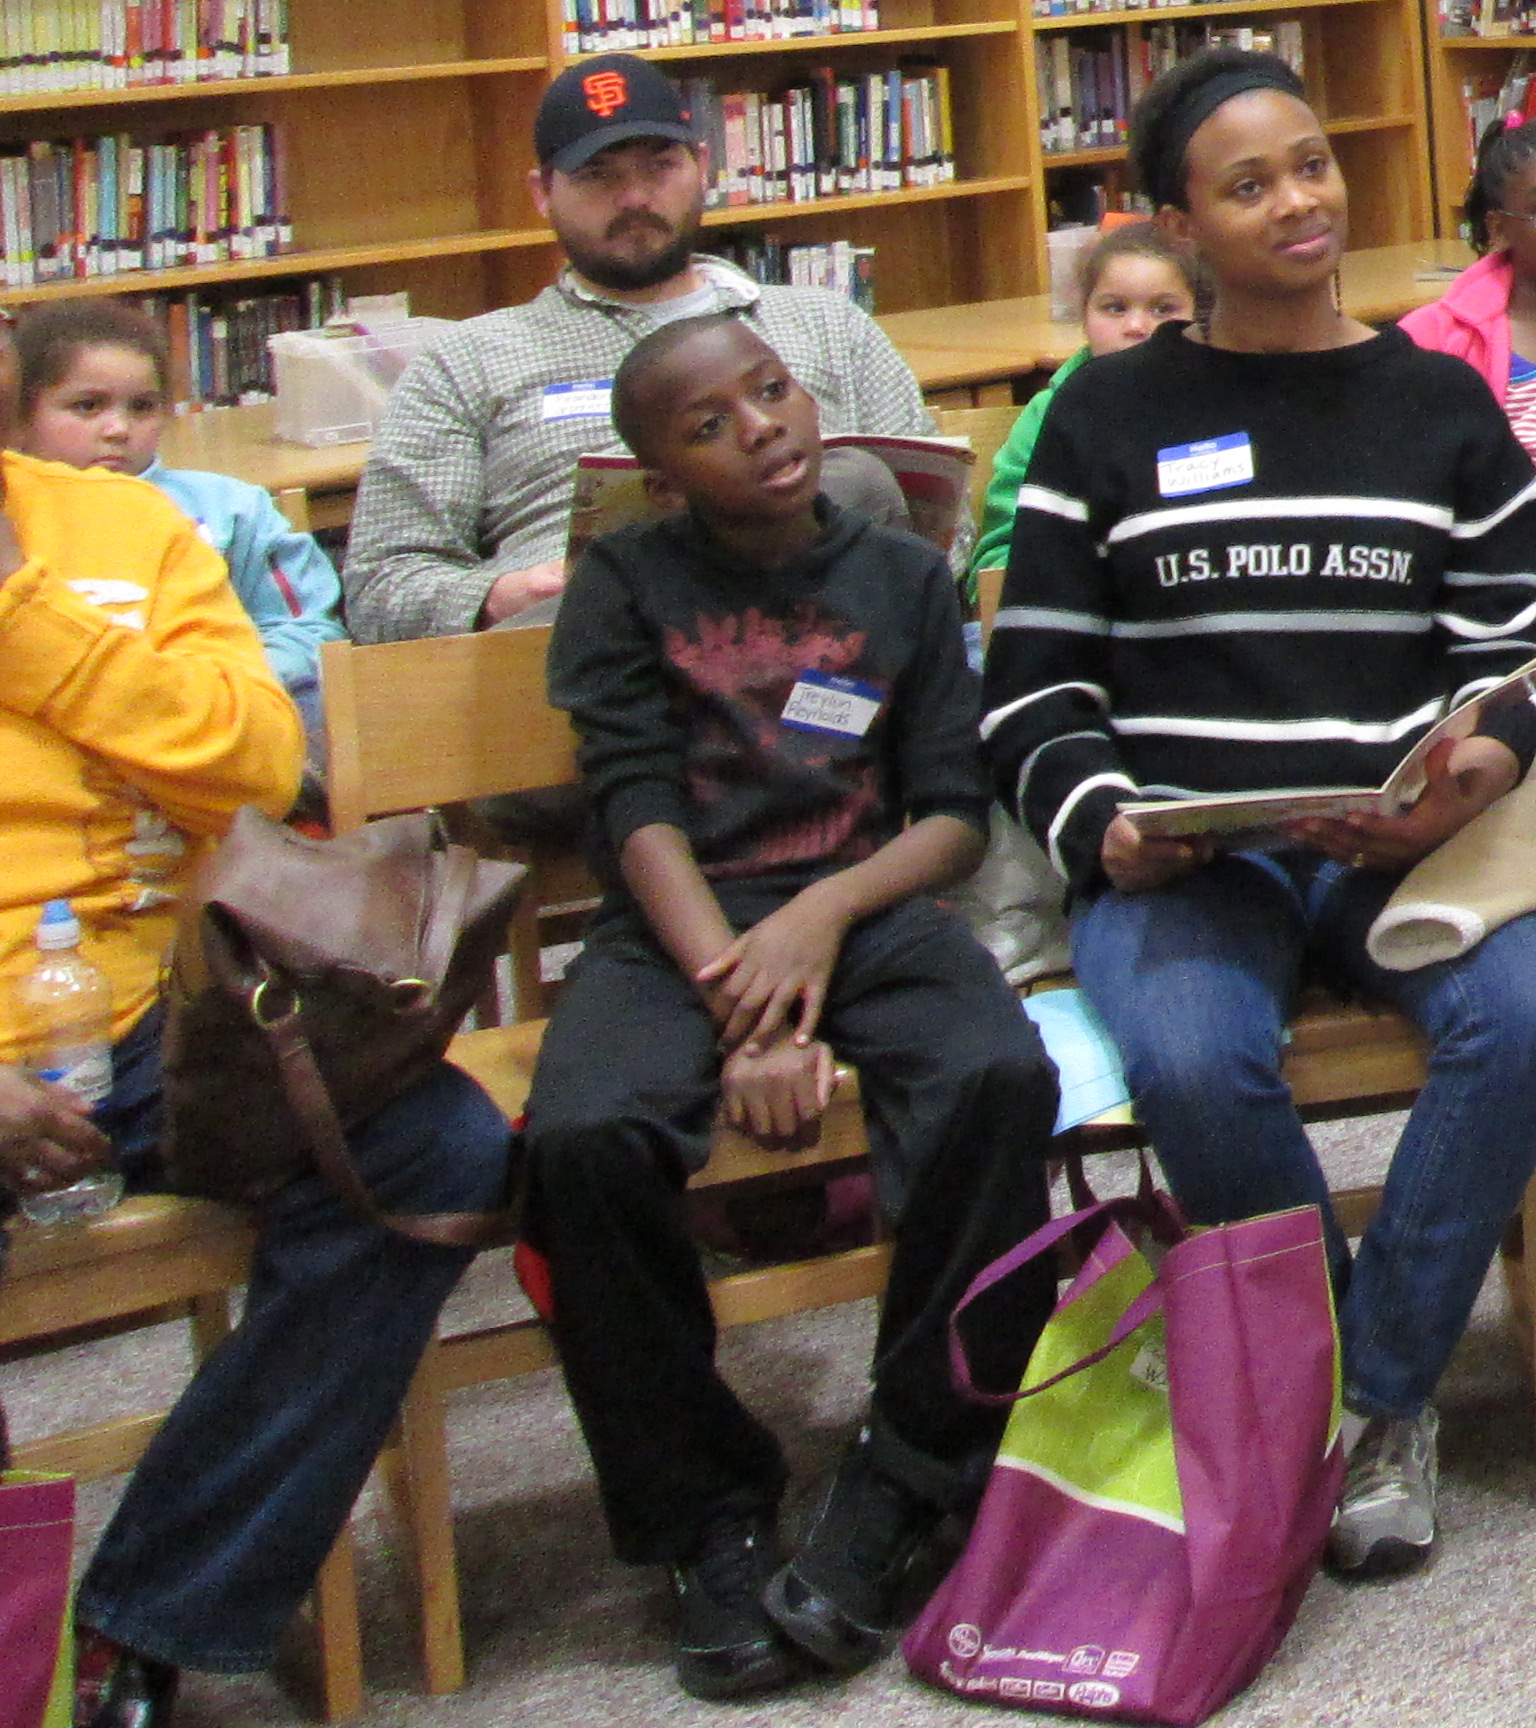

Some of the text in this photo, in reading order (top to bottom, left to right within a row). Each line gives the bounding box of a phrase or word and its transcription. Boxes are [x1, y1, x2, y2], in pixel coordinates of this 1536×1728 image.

[1164, 456, 1221, 474] Tracy
[1167, 464, 1246, 487] Williams
[1155, 542, 1415, 588] U.S. POLO ASSN.
